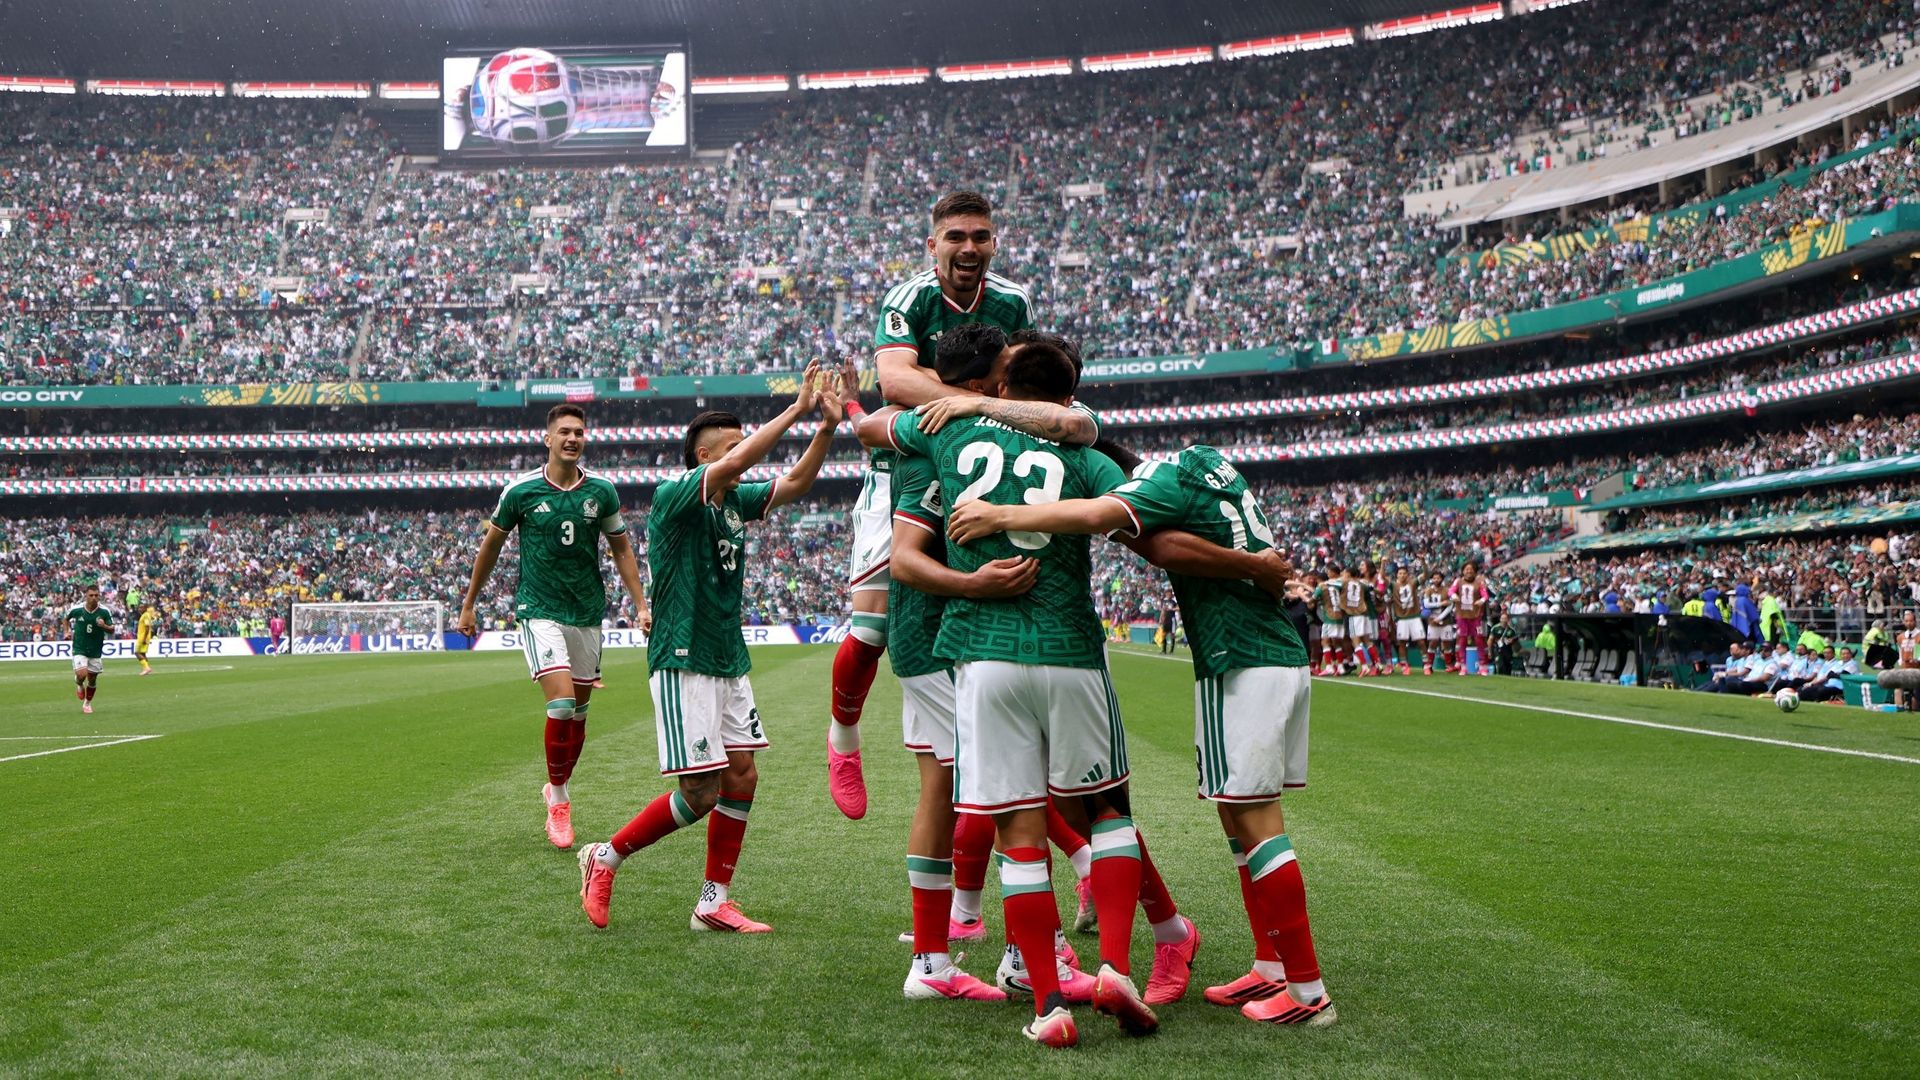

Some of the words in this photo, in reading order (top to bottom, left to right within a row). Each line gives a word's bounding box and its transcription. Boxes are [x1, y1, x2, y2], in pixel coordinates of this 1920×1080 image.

[1080, 361, 1156, 377] MEXICO
[1160, 358, 1206, 372] CITY
[36, 390, 83, 402] CITY
[531, 384, 566, 395] #FIFAWo
[952, 441, 1065, 550] 23
[561, 520, 574, 546] 3
[87, 625, 92, 634] 6
[159, 640, 222, 655] BEER
[368, 634, 444, 651] ULTRA
